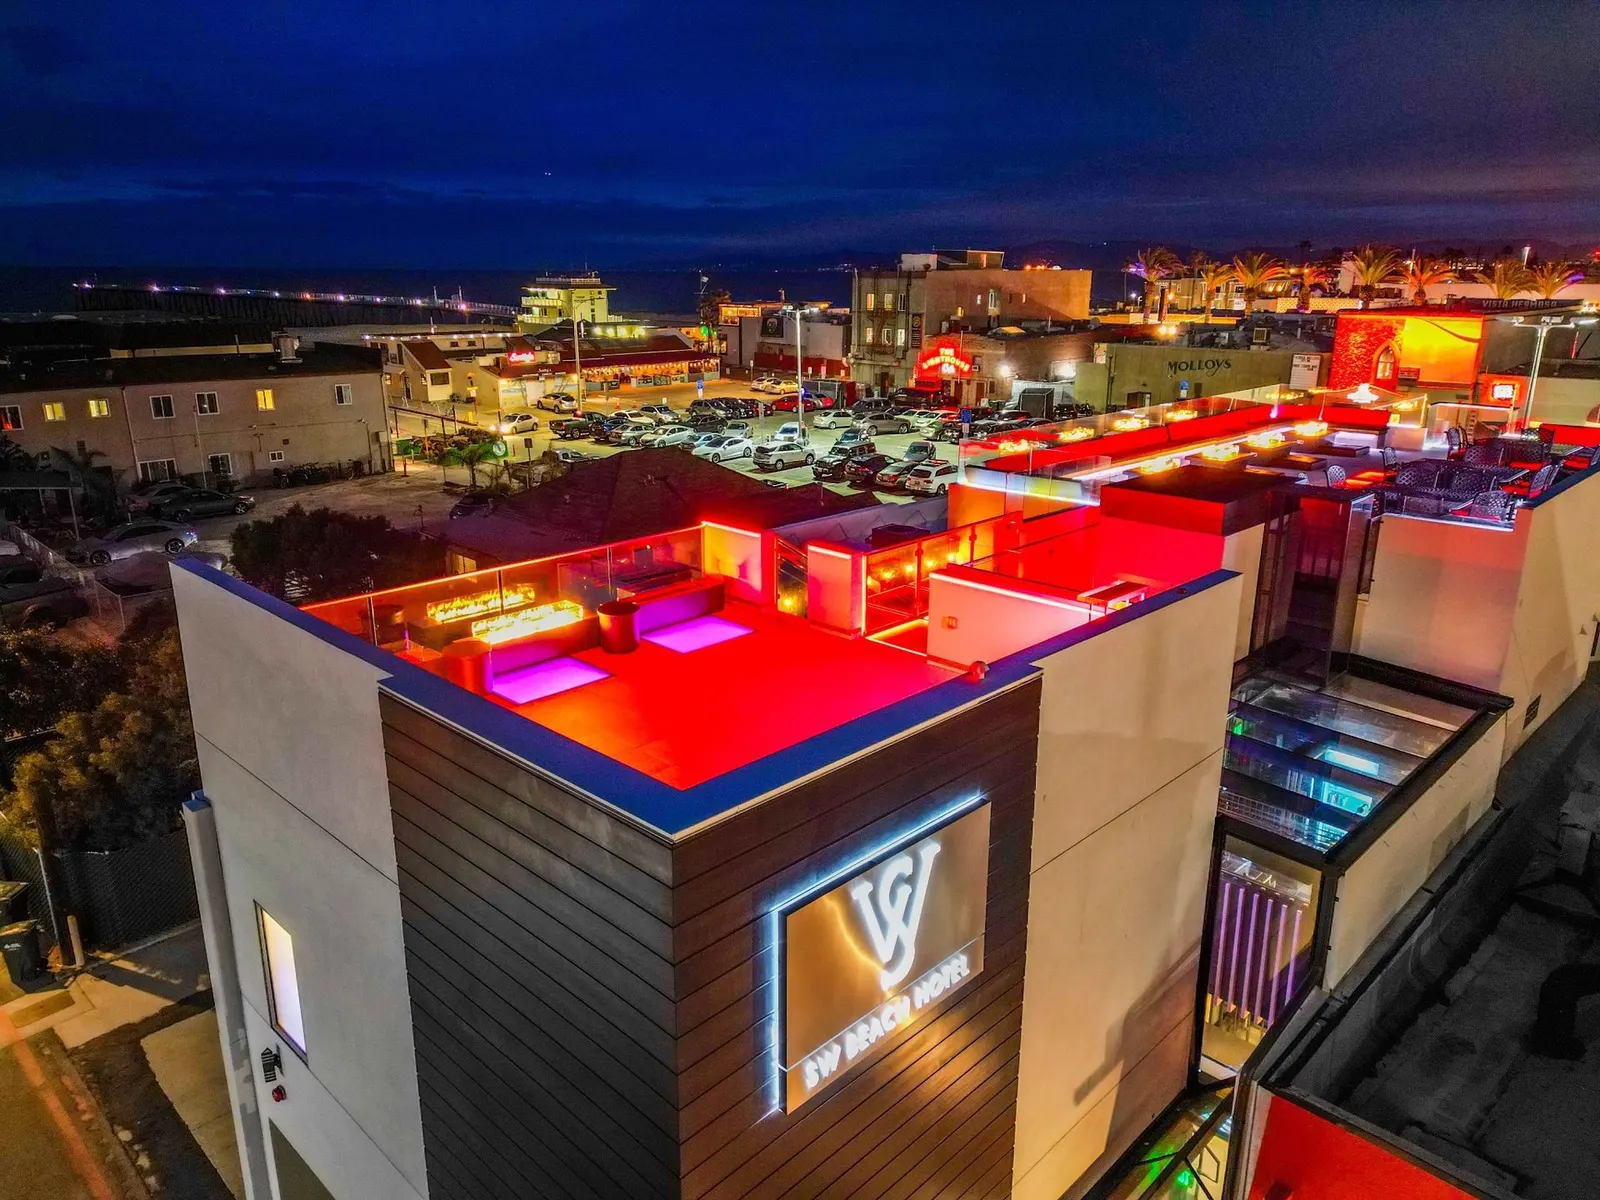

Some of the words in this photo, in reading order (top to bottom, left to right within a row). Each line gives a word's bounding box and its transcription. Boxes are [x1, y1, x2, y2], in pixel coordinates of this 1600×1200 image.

[1482, 300, 1508, 309] VISTA
[939, 347, 955, 356] THE
[922, 355, 971, 372] LIGHTHOUSE
[804, 1043, 841, 1090] SW
[845, 995, 911, 1060] BEACH
